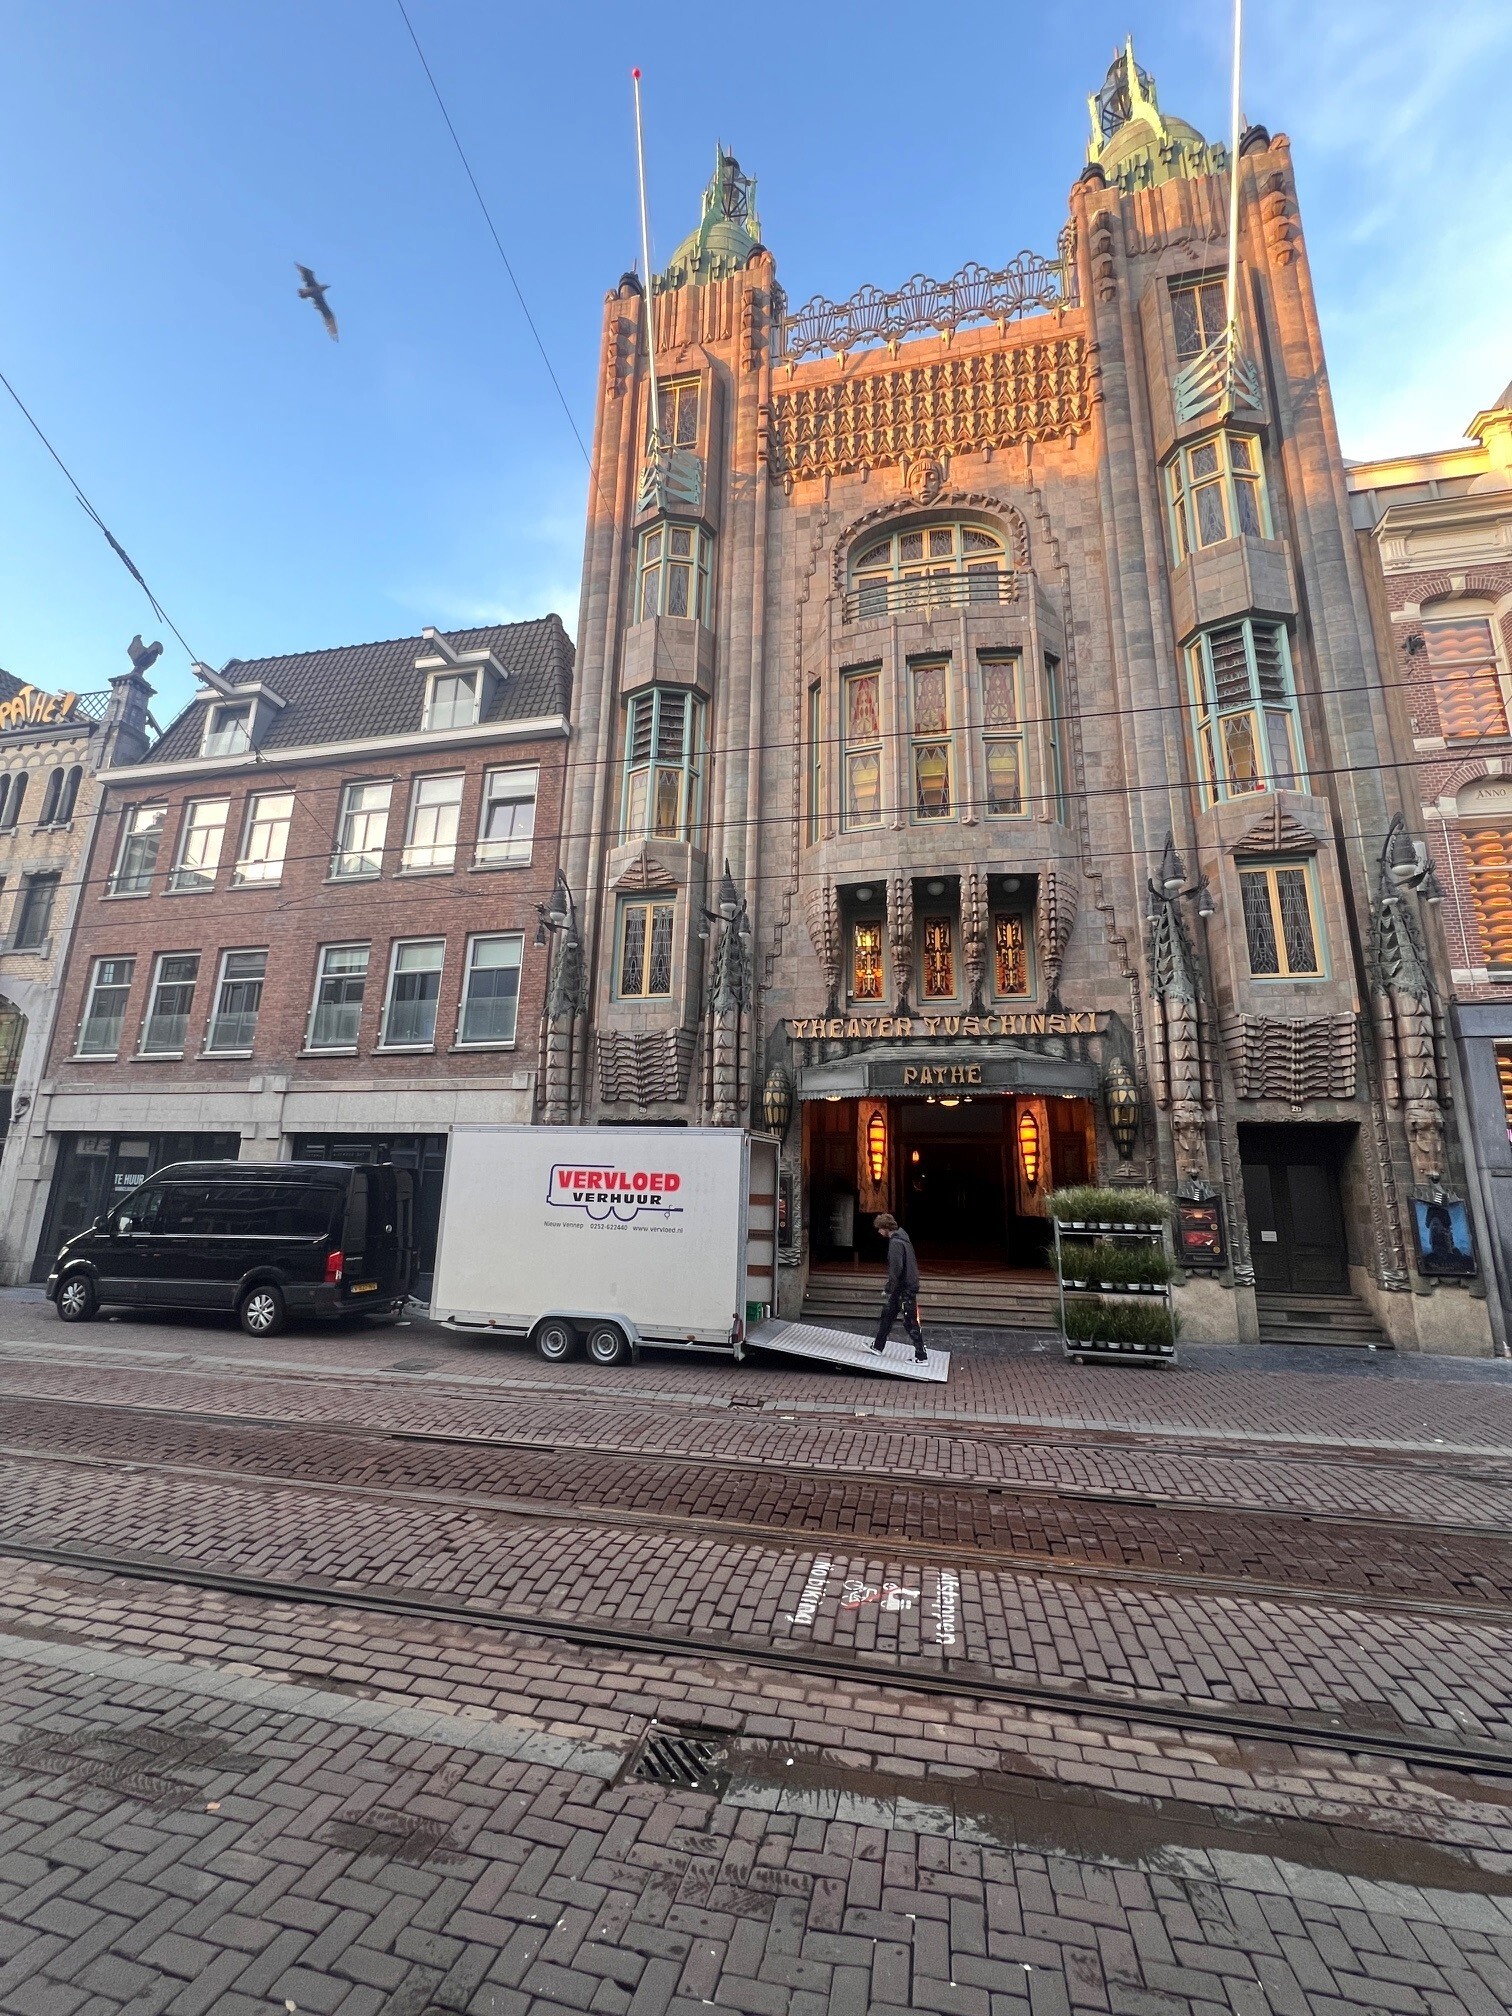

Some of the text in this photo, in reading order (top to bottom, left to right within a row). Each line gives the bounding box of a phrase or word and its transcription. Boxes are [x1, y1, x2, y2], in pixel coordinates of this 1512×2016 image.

[1476, 788, 1507, 799] ANNO
[792, 1012, 1098, 1039] THEATER TUSCHINSKI
[114, 1174, 145, 1185] TE HUUR
[558, 1170, 681, 1192] VERVLOED
[573, 1192, 662, 1205] VERHUUR
[562, 1221, 584, 1229] Vennep
[632, 1225, 684, 1234] www.vervloed.nl
[785, 1561, 835, 1625] No biking
[931, 1572, 959, 1645] Afstappen
